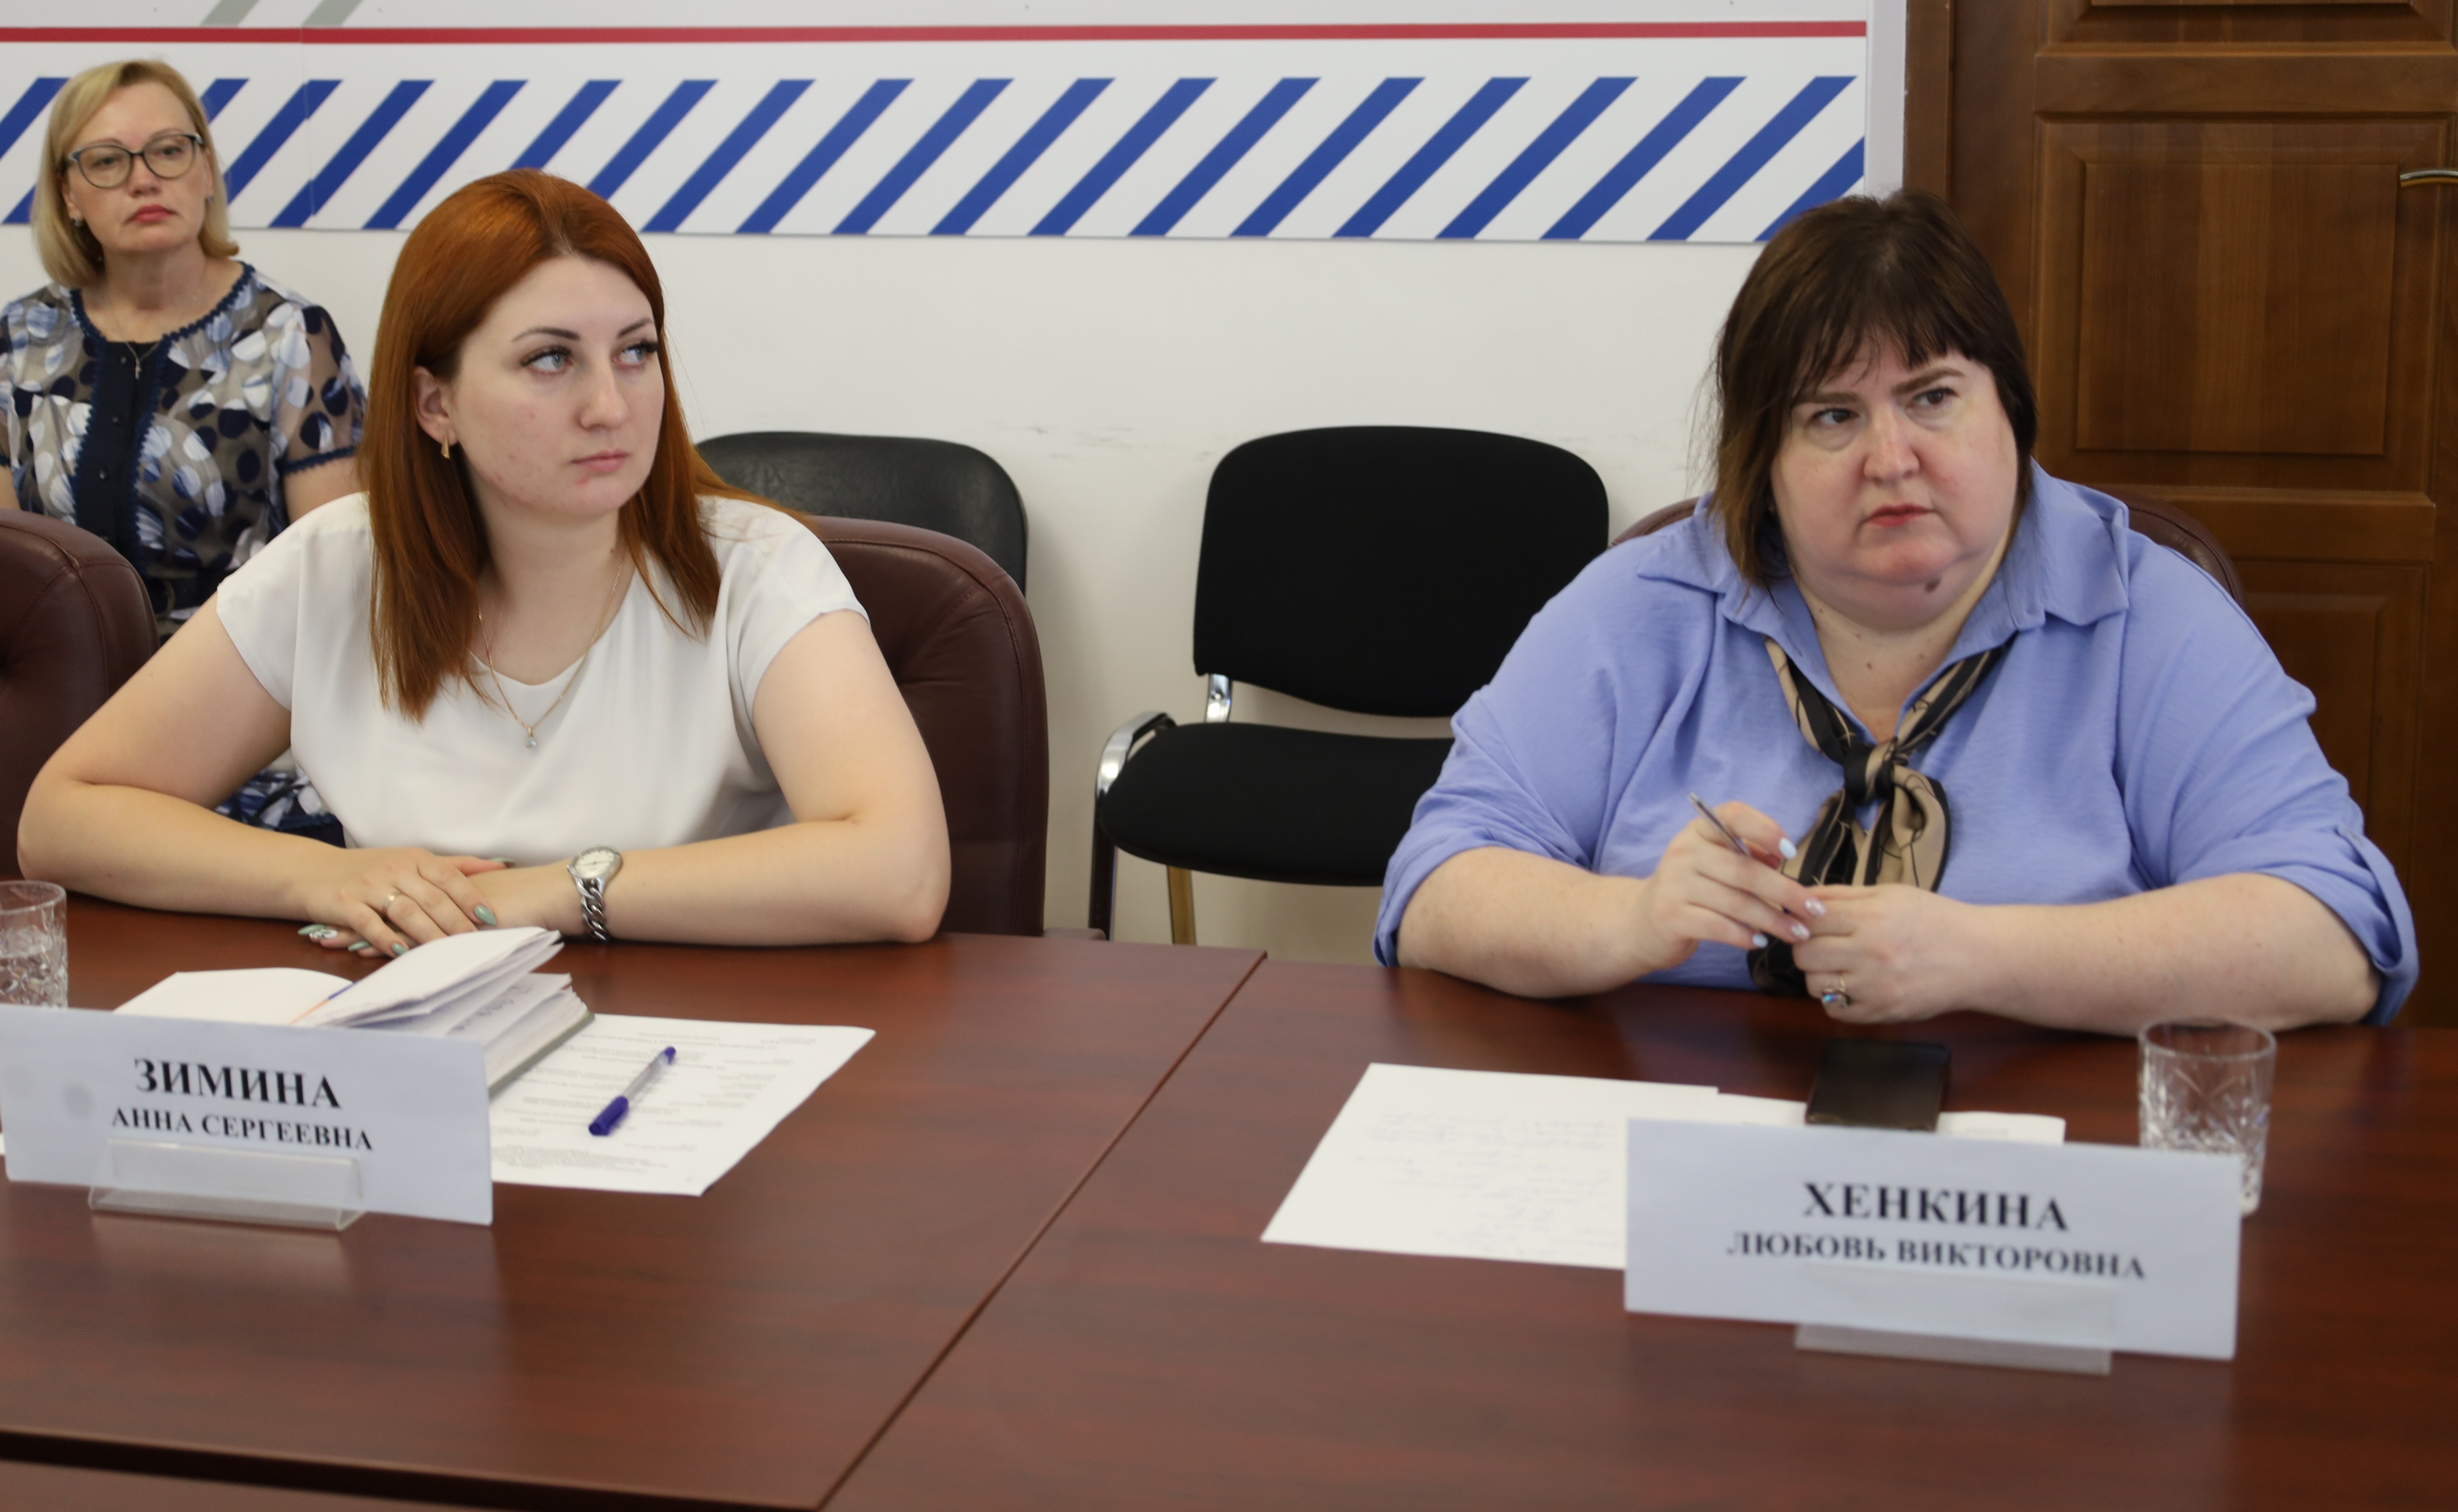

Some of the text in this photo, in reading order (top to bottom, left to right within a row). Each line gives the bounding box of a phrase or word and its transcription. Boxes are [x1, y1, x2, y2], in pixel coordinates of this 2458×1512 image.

[134, 1058, 341, 1109] ЗИМИНА
[112, 1107, 373, 1150] АННА СЕРГЕЕВНА
[1802, 1182, 2069, 1232] ХЕНКИНА
[1727, 1232, 2145, 1279] ЛЮБОВЬ ВИКТОРОВНА
